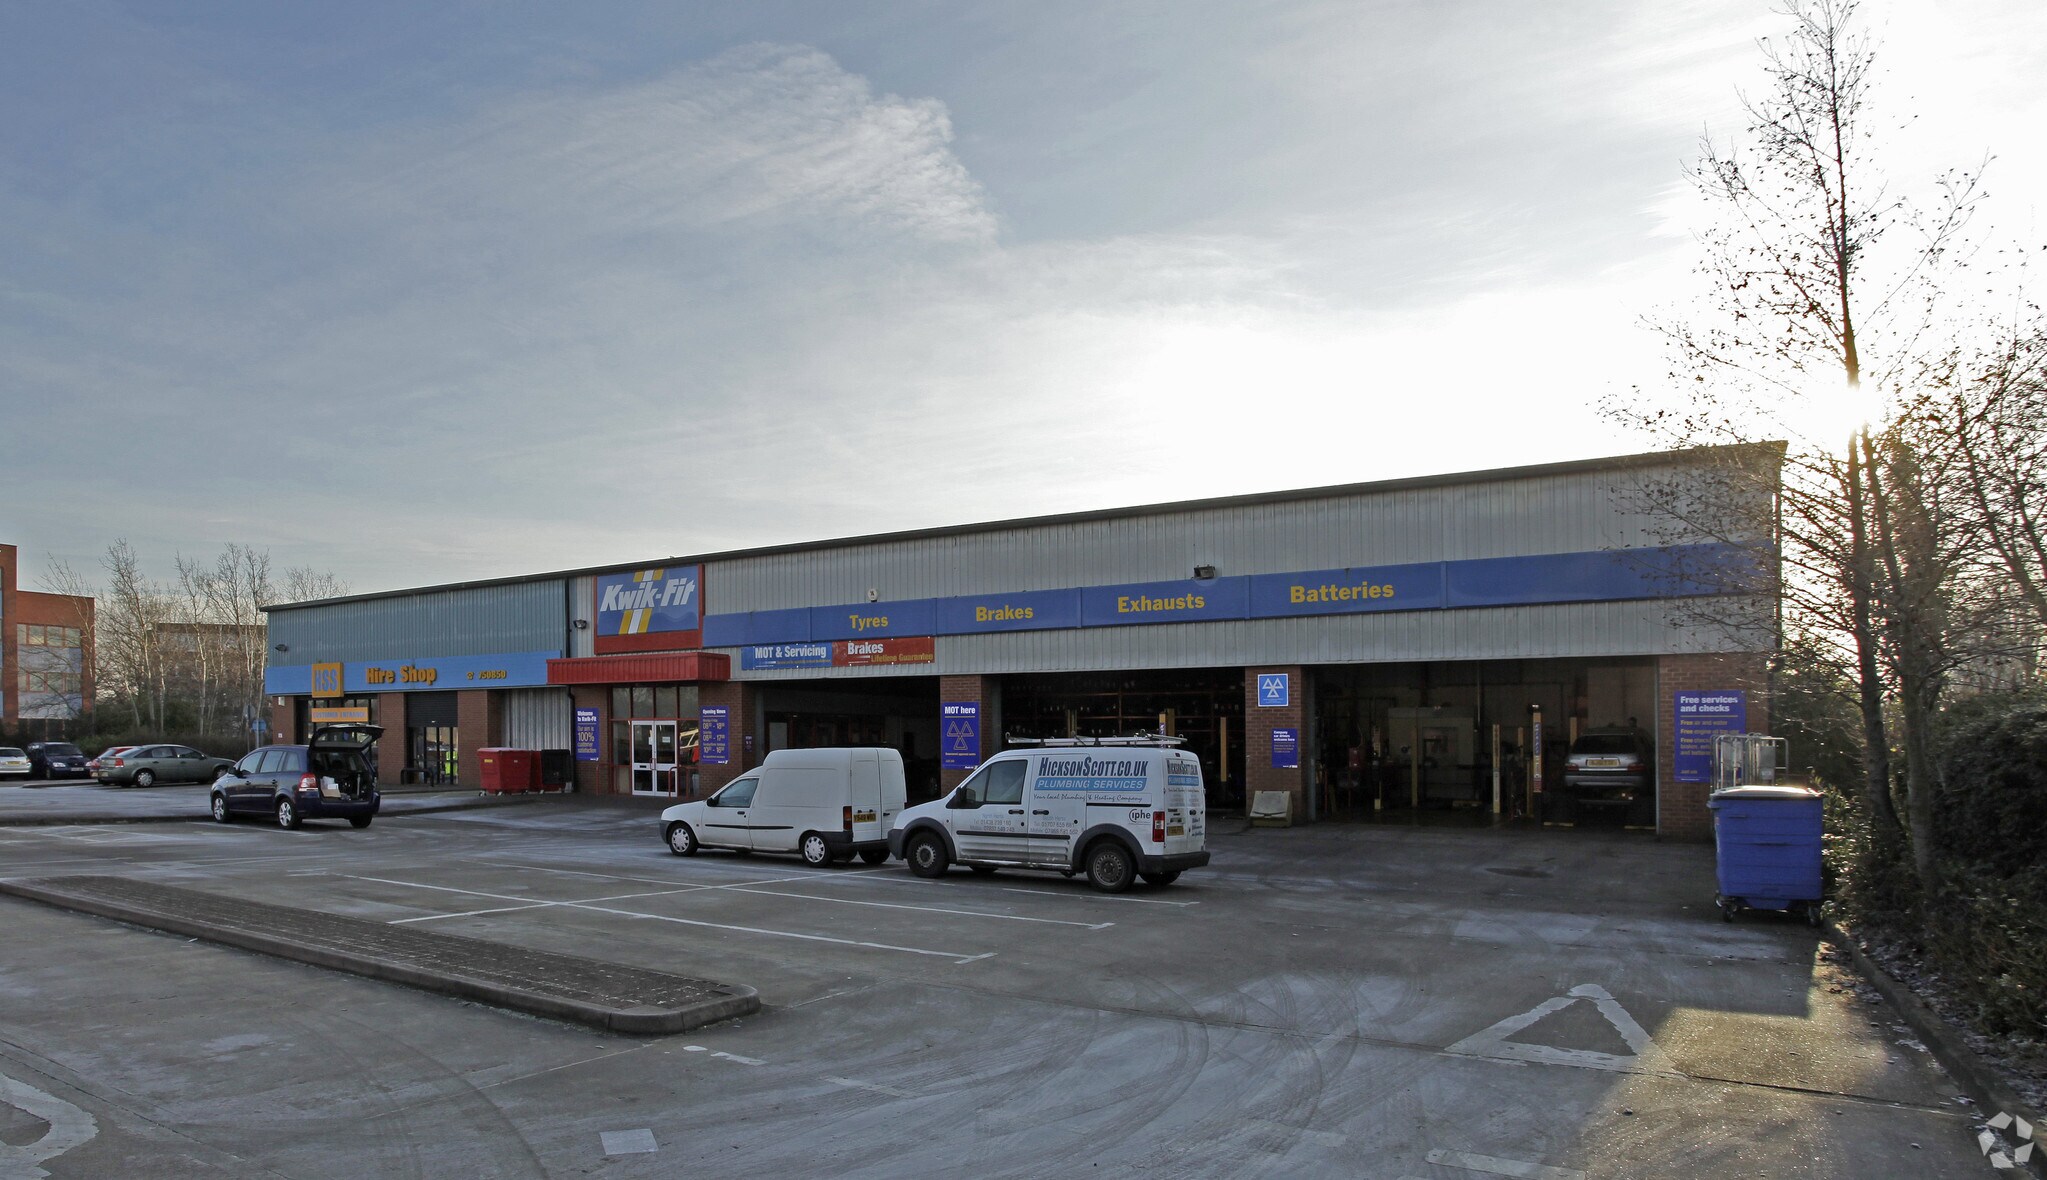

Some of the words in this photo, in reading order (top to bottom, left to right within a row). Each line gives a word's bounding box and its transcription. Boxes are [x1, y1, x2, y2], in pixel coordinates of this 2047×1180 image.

[600, 577, 696, 612] Kwik-Fit
[1290, 581, 1395, 603] Batteries
[1117, 593, 1205, 613] Exhausts
[975, 604, 1034, 622] Brakes
[849, 614, 889, 632] Tyres
[755, 646, 774, 659] MOT
[775, 646, 783, 658] &
[784, 644, 827, 659] Servicing
[847, 641, 884, 655] Brakes
[315, 669, 338, 692] HSS
[366, 666, 396, 685] Hire
[400, 664, 437, 686] Shop
[944, 706, 960, 715] MOT
[960, 705, 976, 715] here
[577, 731, 595, 742] 100%
[1037, 780, 1090, 789] PLUMBING
[1093, 780, 1144, 789] SERVICES
